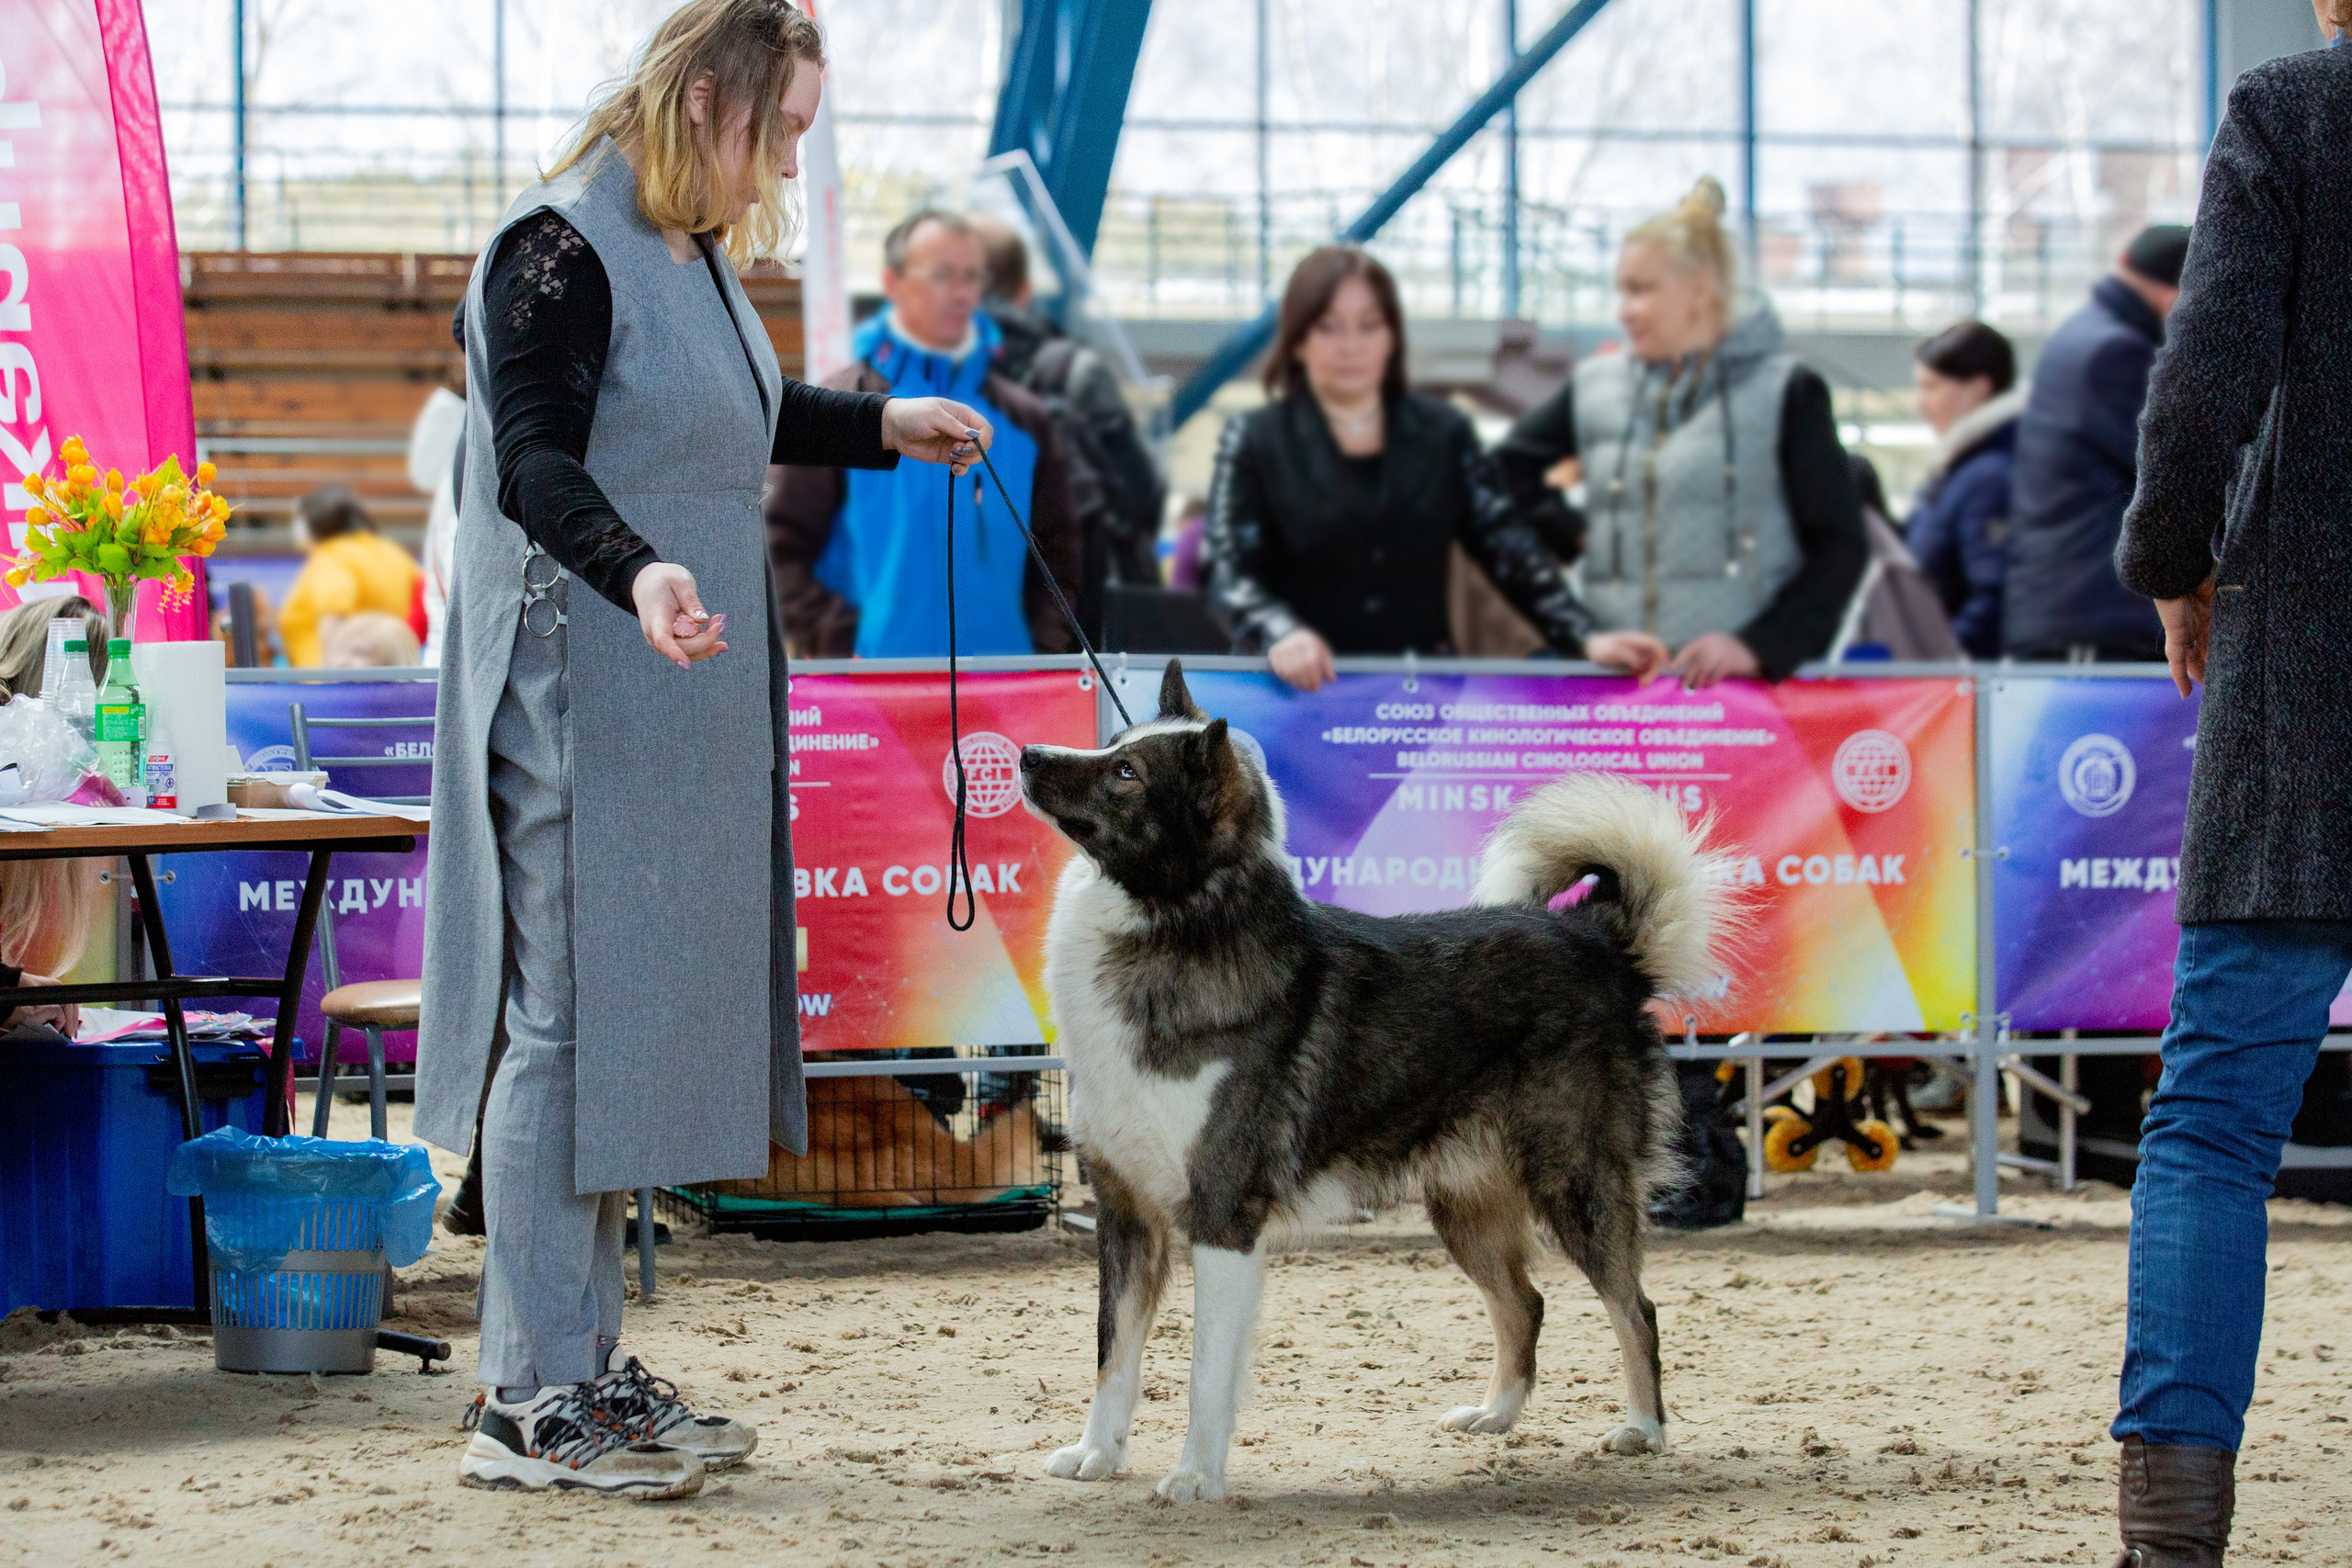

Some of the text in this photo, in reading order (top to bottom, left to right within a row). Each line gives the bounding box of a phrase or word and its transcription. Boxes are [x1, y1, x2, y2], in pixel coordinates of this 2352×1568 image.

[1376, 702, 1724, 723] СОЮЗ ОБЩЕСТВЕННЫХ ОБЪЕДИНЕНИЙ
[1322, 727, 1777, 746] «БЕЛОРУССКОЕ КИНОЛОГИЧЕСКОЕ ОБЪЕДИНЕНИЕ»
[1521, 751, 1642, 769] CINOLOGICAL
[1646, 751, 1703, 769] UNION
[1397, 784, 1513, 811] MINSK
[882, 863, 1022, 896] СОБАК
[1776, 854, 1905, 886] СОБАК
